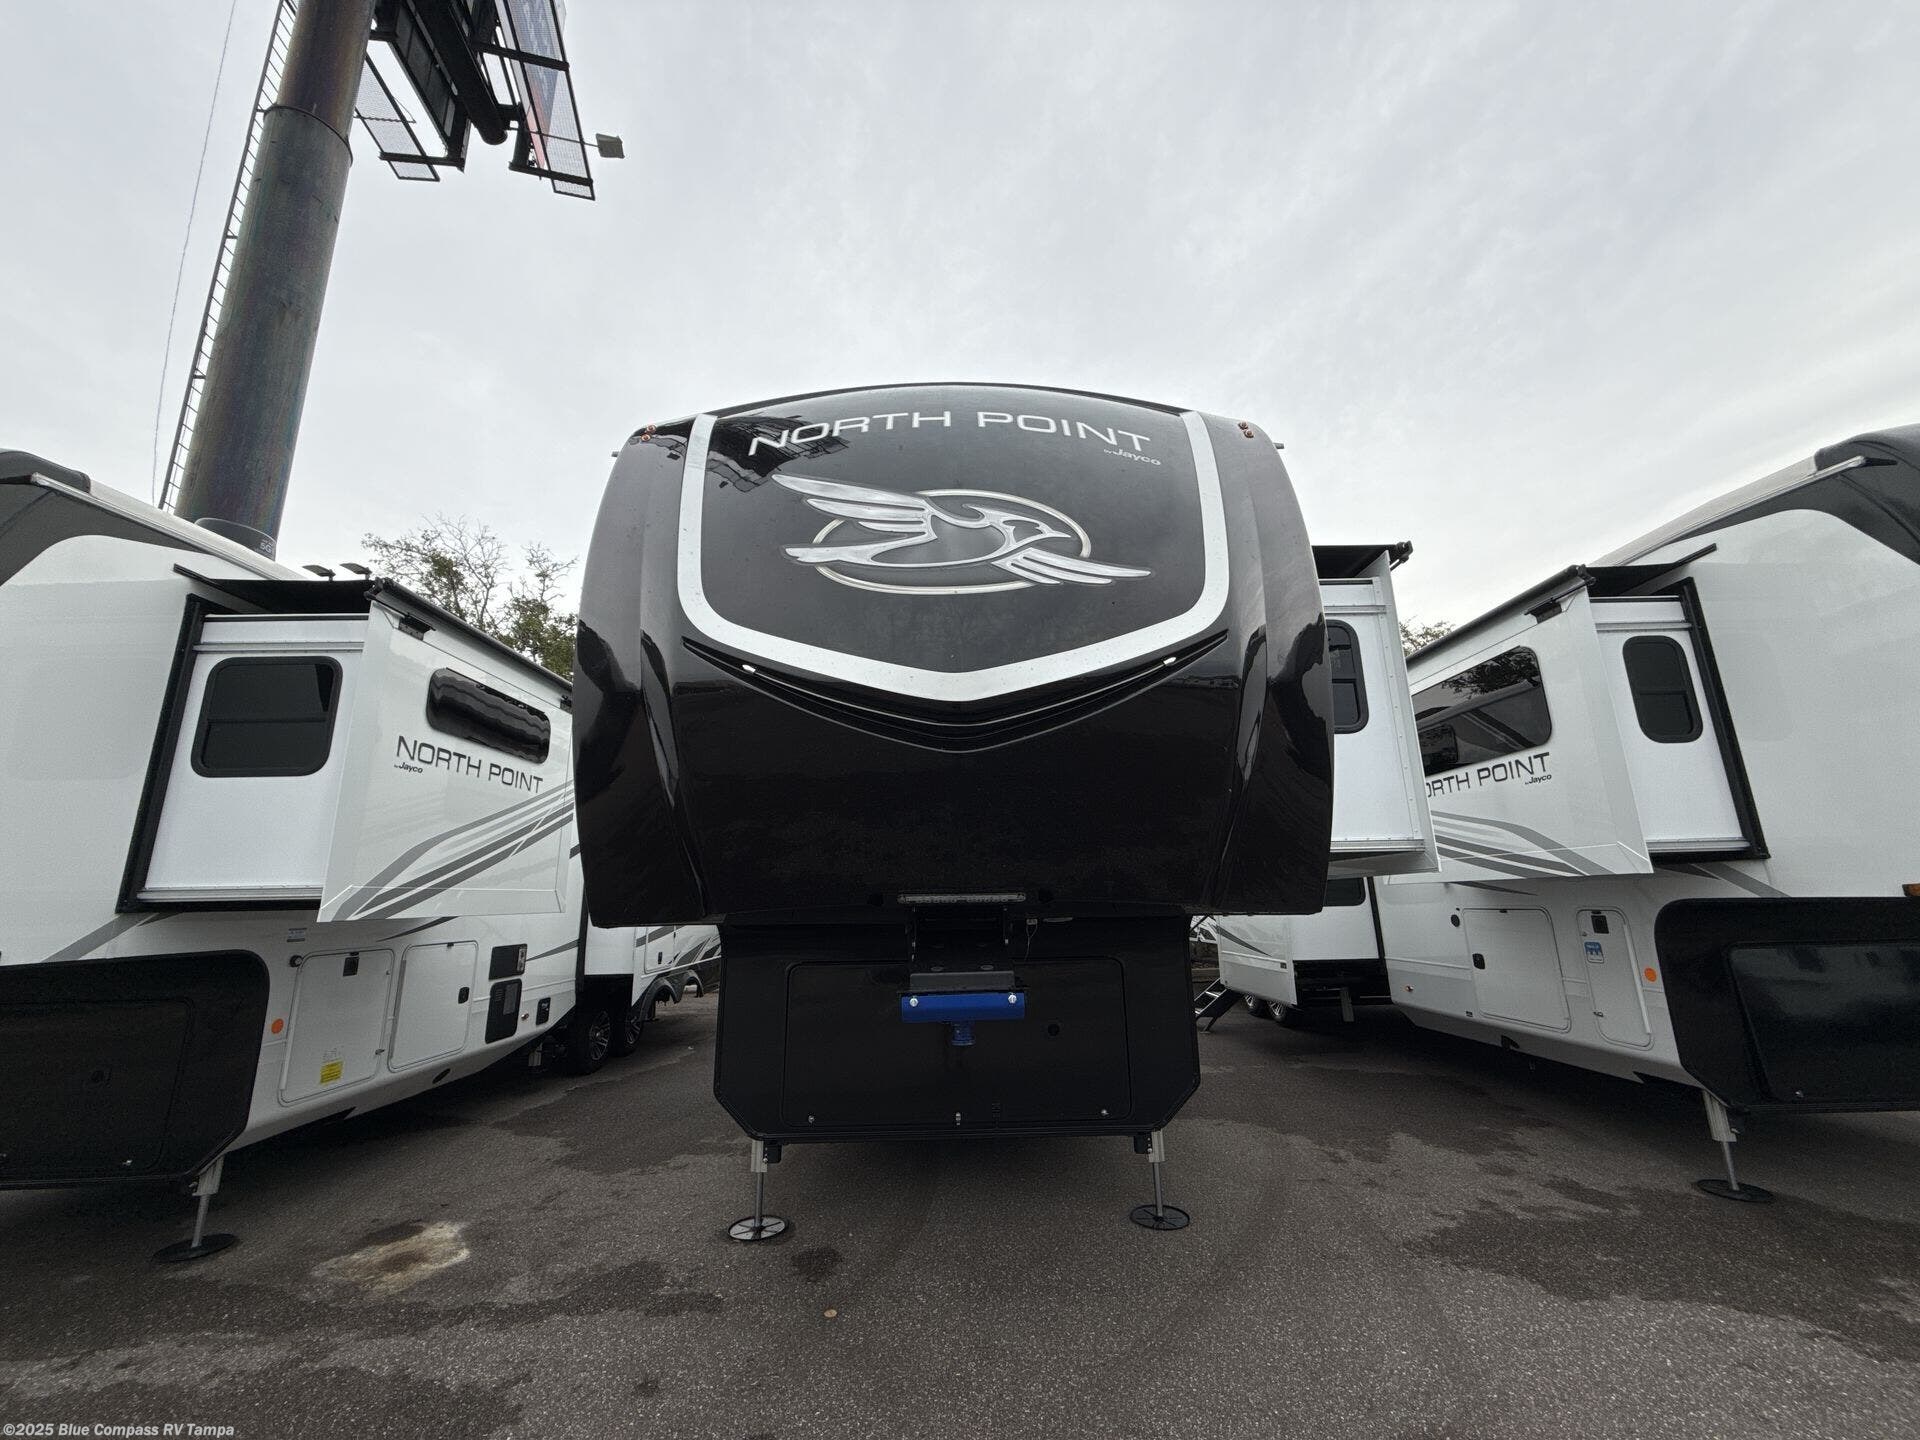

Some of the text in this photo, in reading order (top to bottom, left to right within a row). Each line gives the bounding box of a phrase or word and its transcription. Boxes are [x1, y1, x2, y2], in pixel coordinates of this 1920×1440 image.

[748, 410, 1151, 456] NORTH POINT
[1112, 448, 1162, 466] Jayco
[396, 735, 544, 794] NORTH POINT
[398, 762, 423, 774] Jayco
[1425, 751, 1550, 798] RTH POINT
[1528, 774, 1552, 785] Jayco
